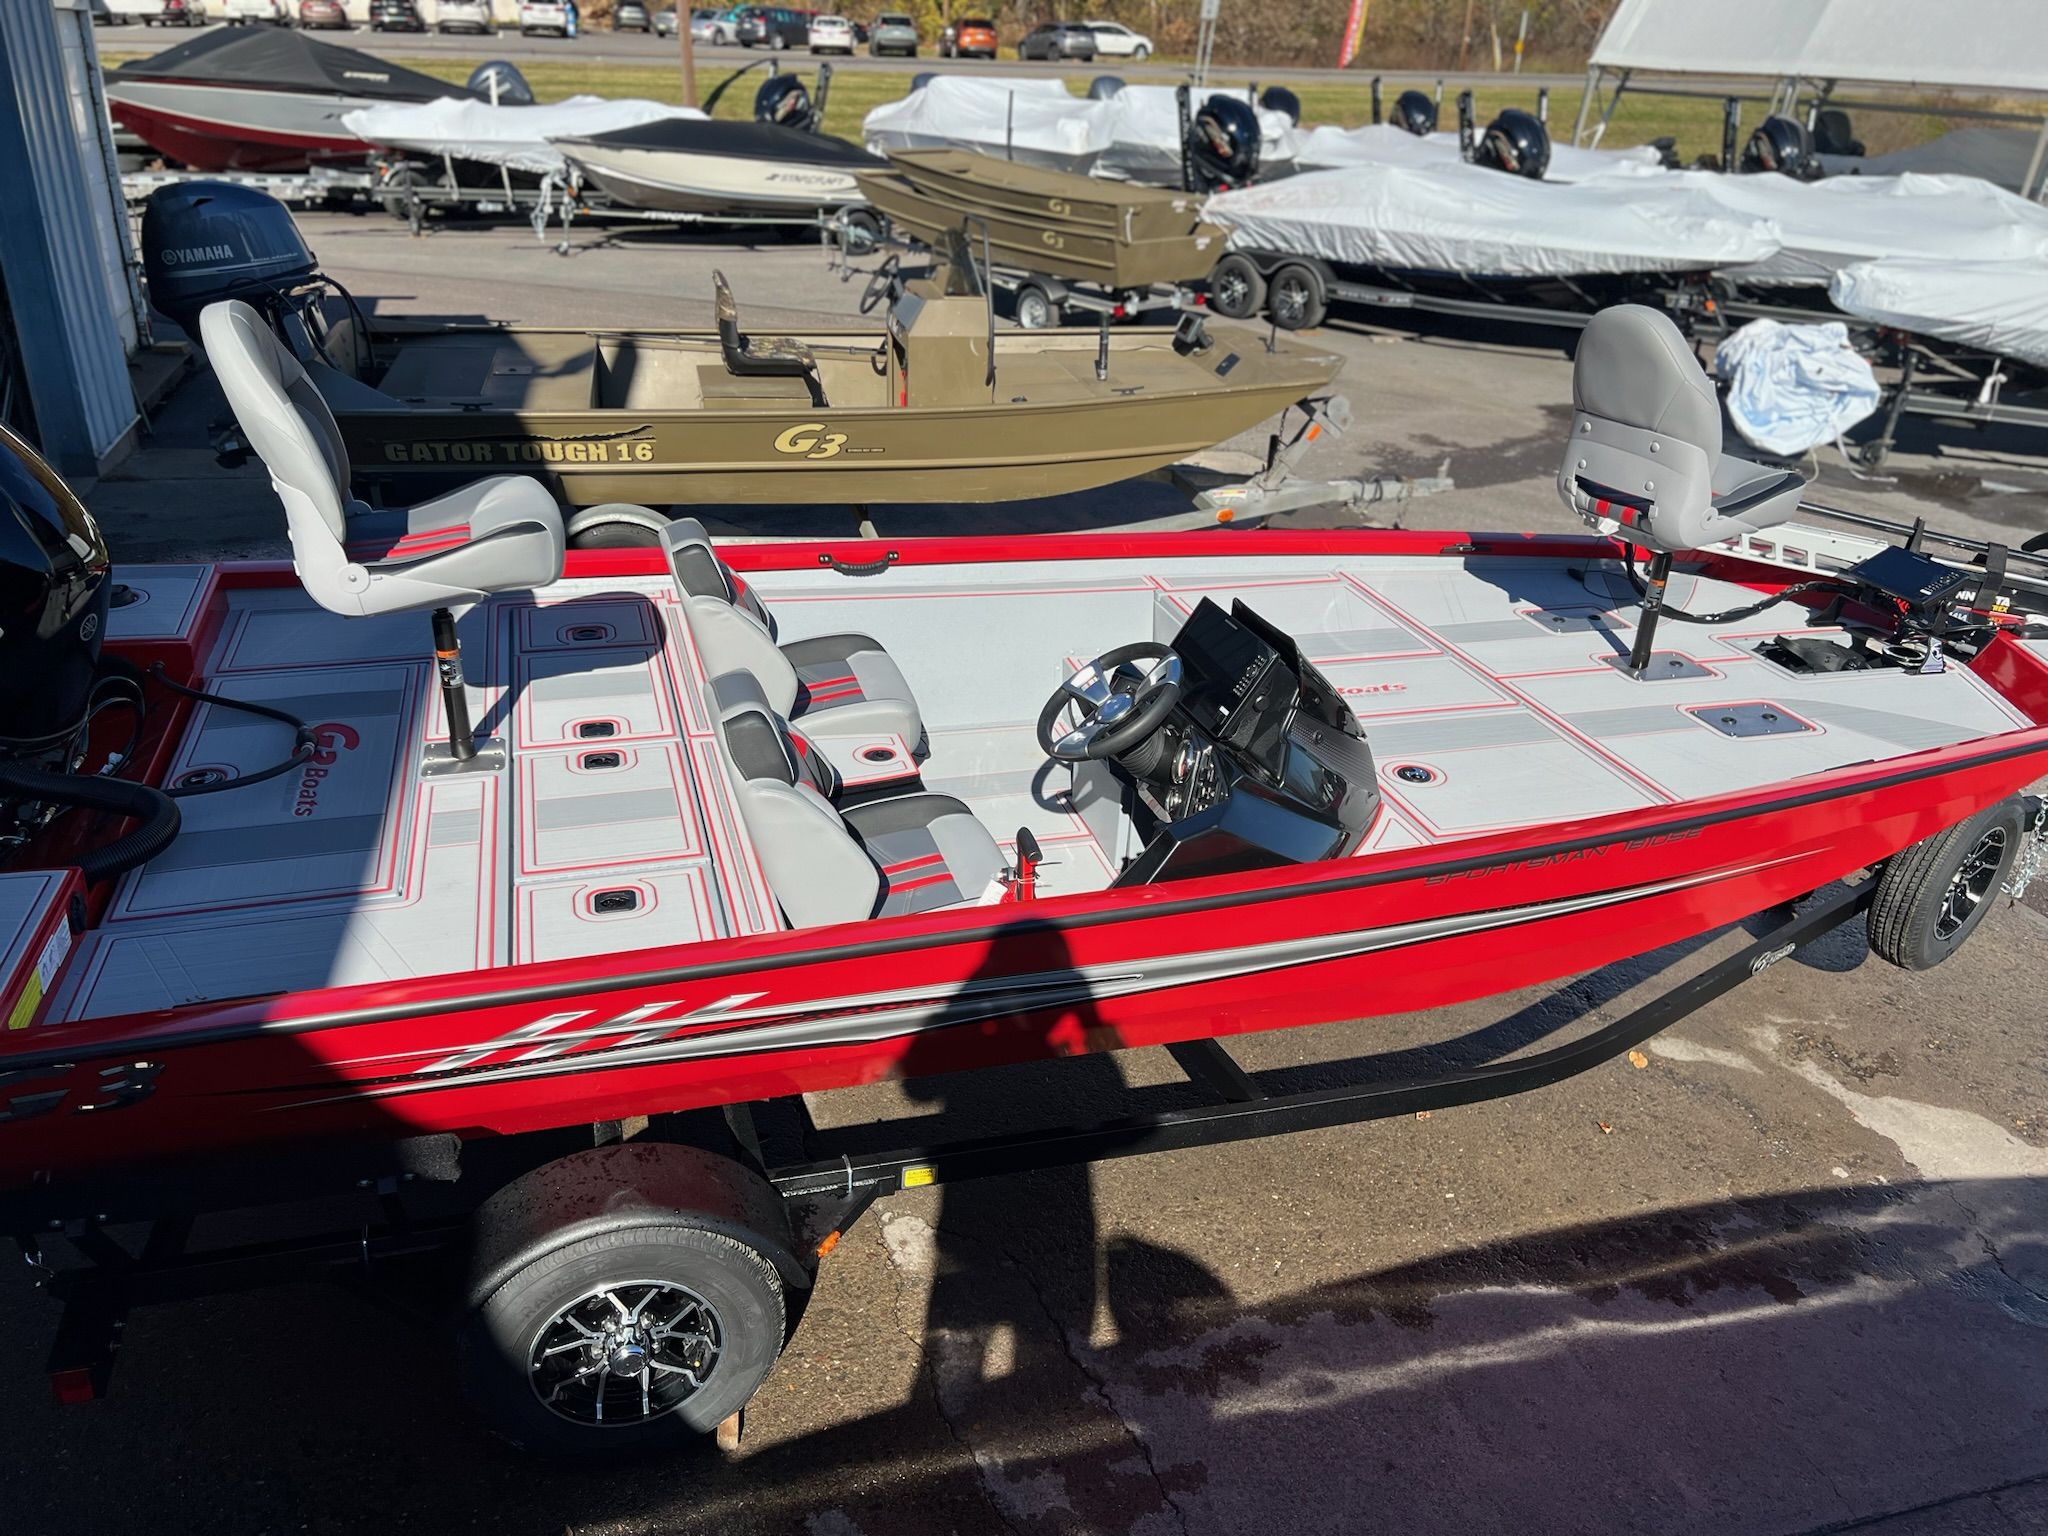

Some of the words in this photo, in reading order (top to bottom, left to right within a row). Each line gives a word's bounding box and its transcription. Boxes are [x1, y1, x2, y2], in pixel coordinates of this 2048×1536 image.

[1048, 198, 1071, 216] G3
[1042, 231, 1065, 248] G3
[176, 244, 235, 264] YAMAHA
[773, 423, 848, 459] G3
[384, 442, 493, 462] GATOR
[503, 442, 609, 462] TOUGH
[617, 442, 655, 462] 16
[294, 767, 329, 817] Boats
[1424, 847, 1609, 886] SPORTSMAN
